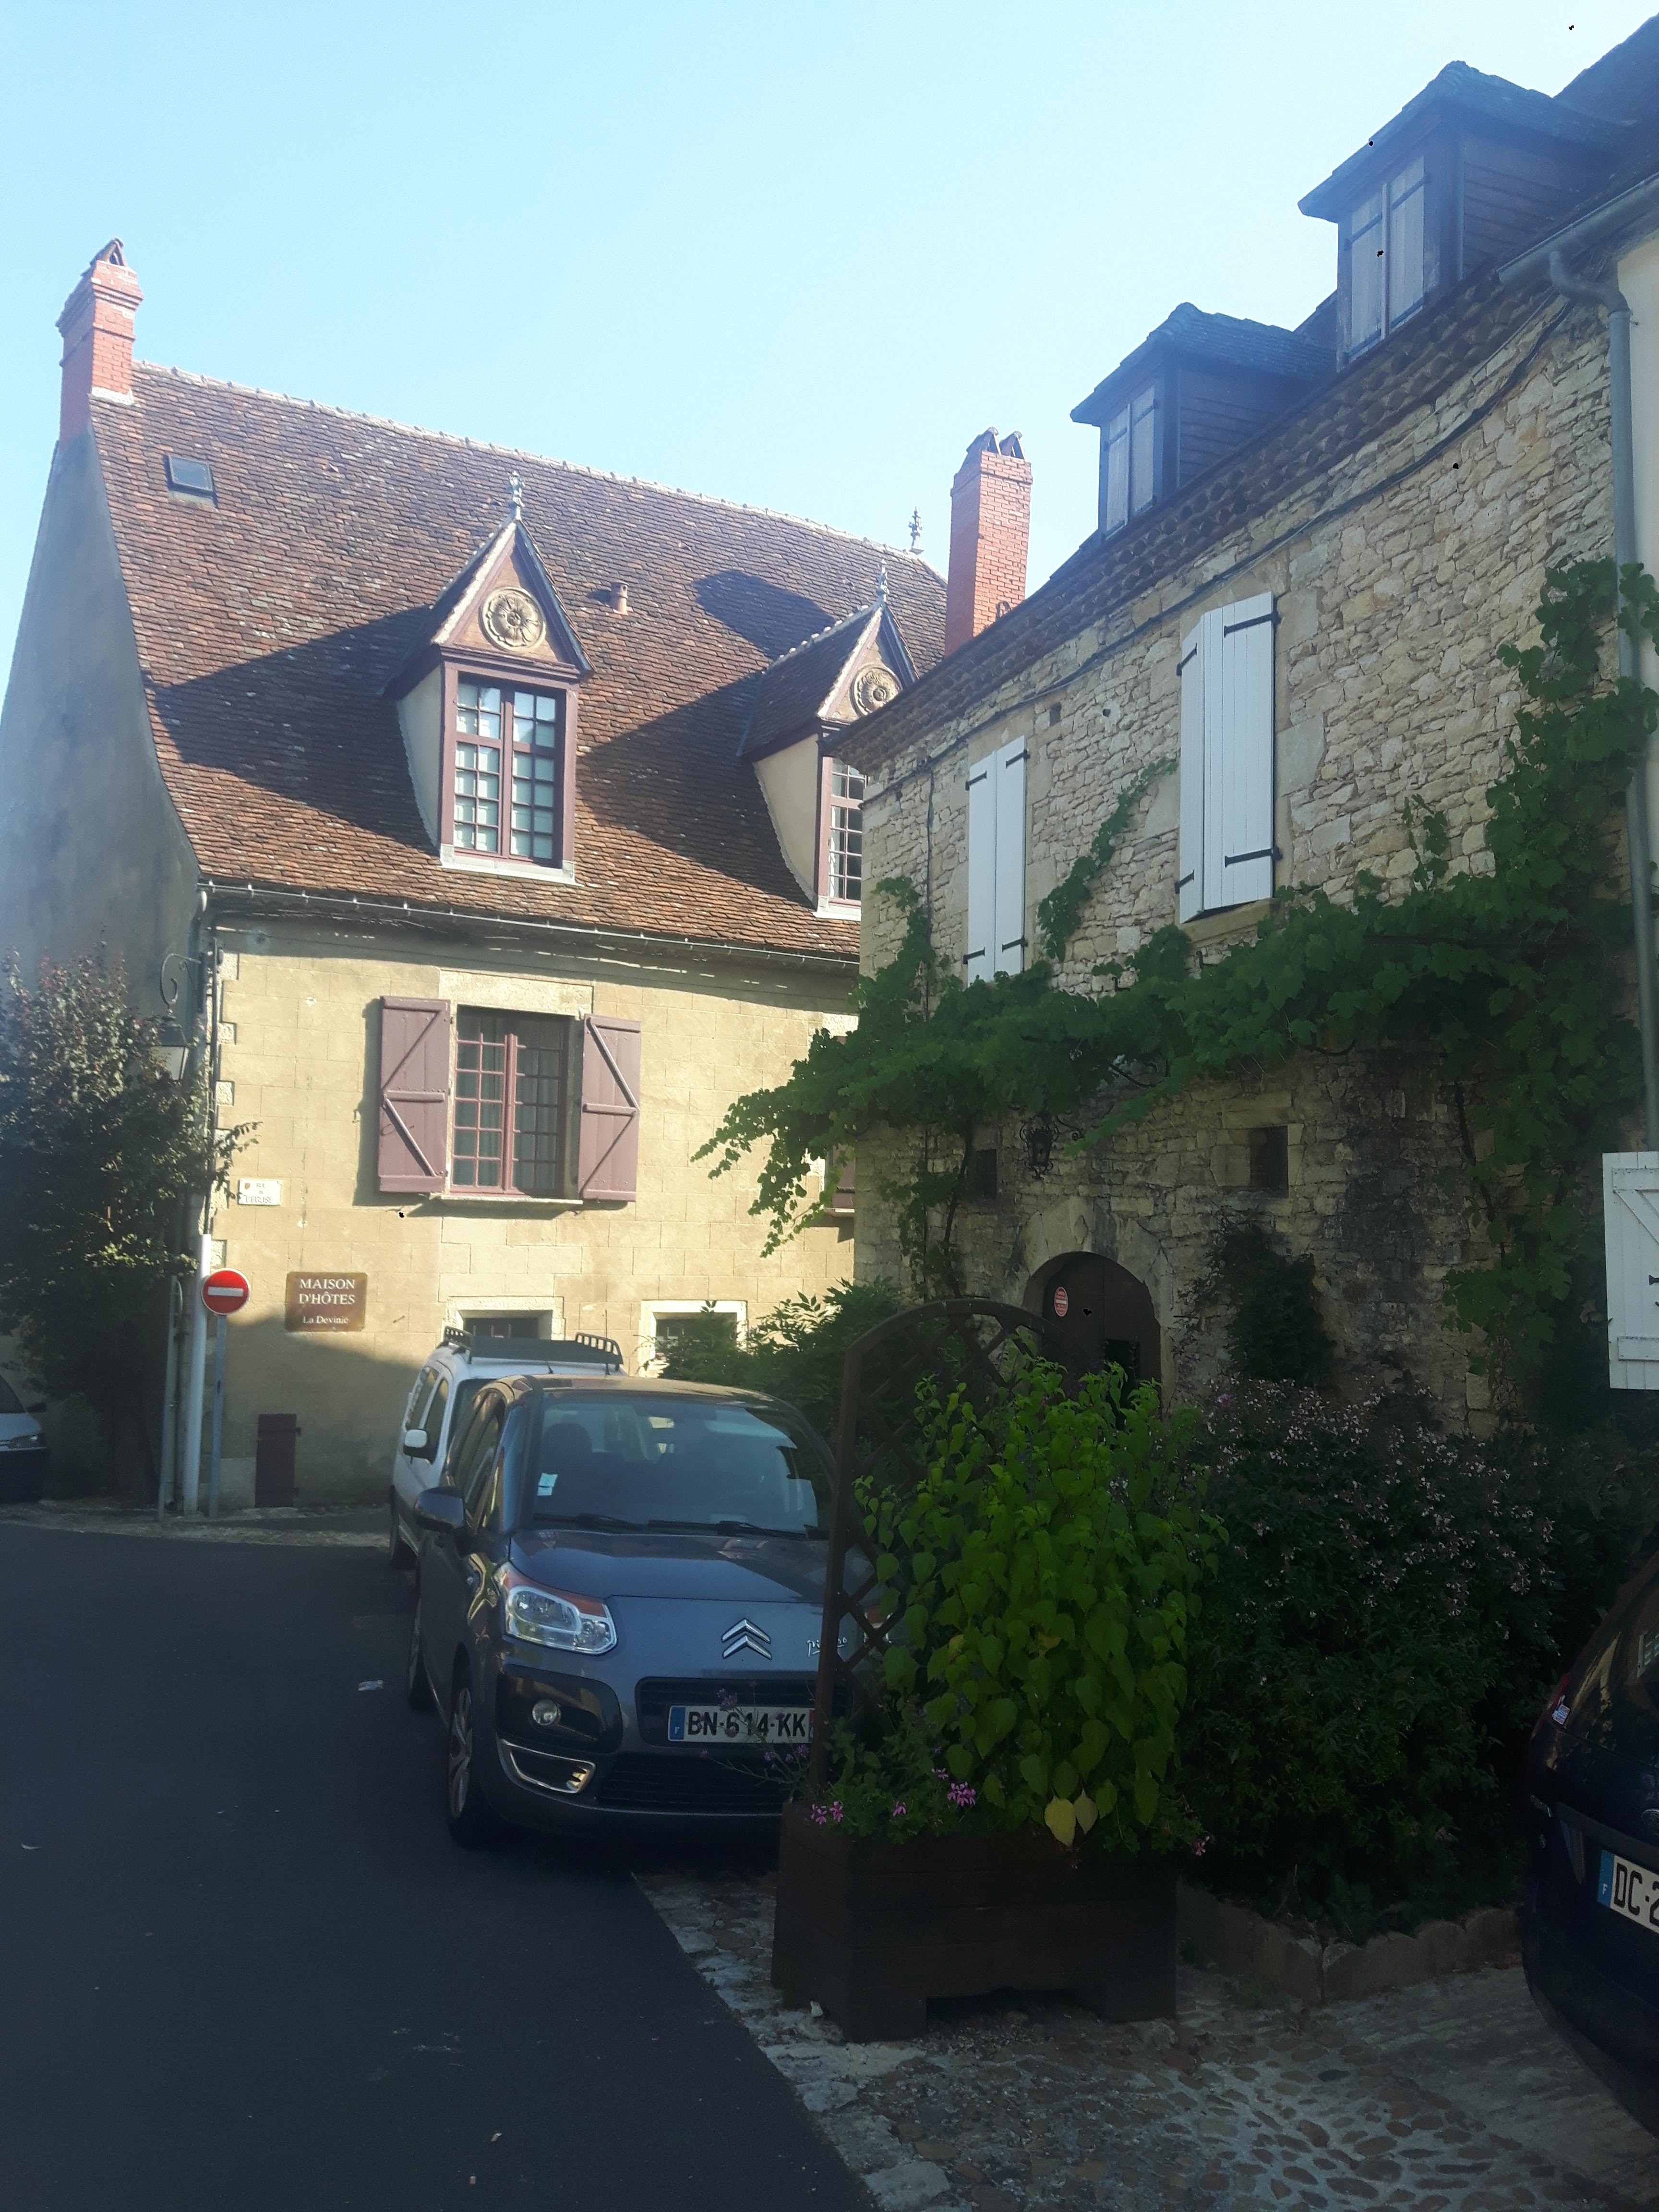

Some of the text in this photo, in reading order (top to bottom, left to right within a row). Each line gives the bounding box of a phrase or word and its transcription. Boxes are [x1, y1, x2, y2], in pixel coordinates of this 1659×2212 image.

[300, 1278, 355, 1290] MAISON
[299, 1291, 356, 1305] D'HÔTES
[303, 1316, 314, 1324] La
[674, 1726, 680, 1734] F
[1602, 1883, 1608, 1895] F
